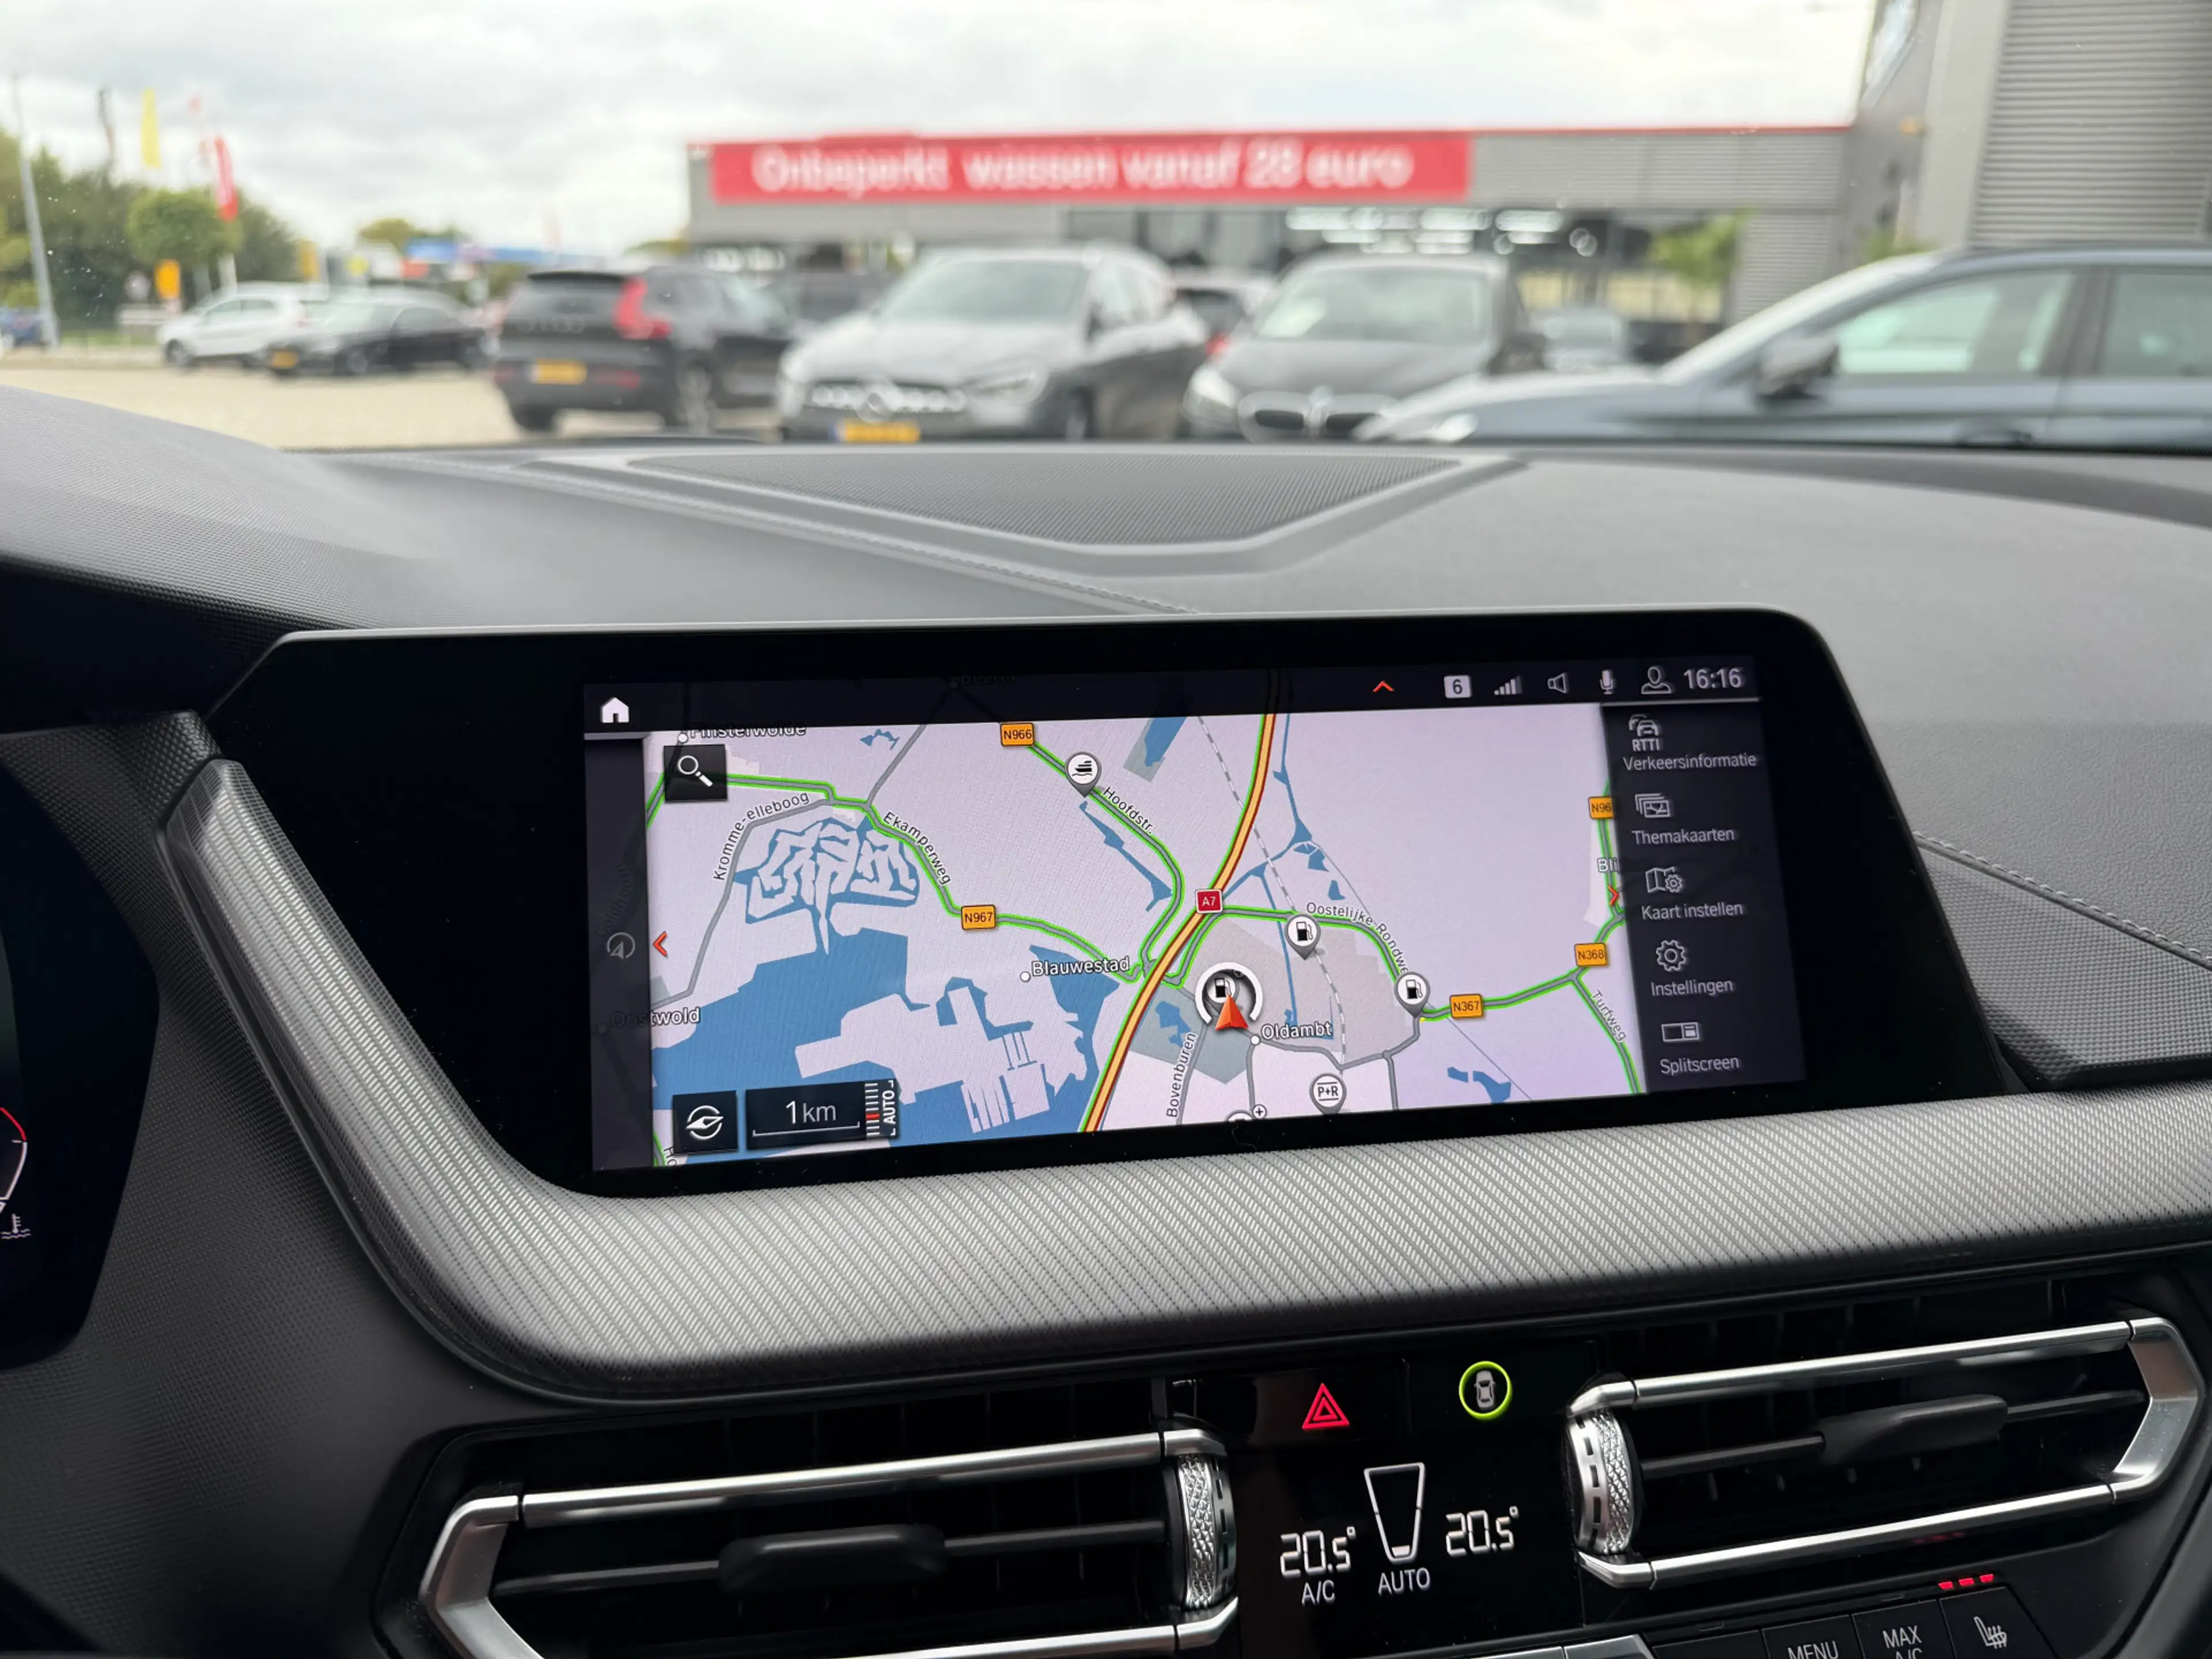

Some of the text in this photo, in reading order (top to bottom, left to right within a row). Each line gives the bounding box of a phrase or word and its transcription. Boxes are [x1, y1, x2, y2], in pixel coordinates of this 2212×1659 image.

[1306, 143, 1414, 189] euro
[1452, 679, 1463, 694] 6
[1683, 667, 1743, 690] 16:16
[1003, 728, 1033, 741] N966
[1631, 738, 1660, 751] RTTI
[1623, 752, 1758, 771] Verkeersinformatie
[1103, 786, 1154, 834] Hoofdstr.
[714, 791, 810, 881] Kromme-elleboog
[1631, 827, 1736, 845] Themakaarten
[882, 811, 952, 887] Ekamperweg
[1202, 895, 1217, 908] A7
[964, 911, 994, 924] N967
[1306, 902, 1373, 926] Oostelijke
[1641, 902, 1744, 921] Kaart instellen
[1578, 949, 1605, 961] N368
[1031, 956, 1130, 976] Blauwestad
[1651, 980, 1735, 998] Instellingen
[1453, 999, 1480, 1013] N367
[1590, 988, 1627, 1042] Turfweg
[1261, 1021, 1334, 1040] Oldambt
[1166, 1032, 1197, 1118] Bovenburen
[1660, 1056, 1740, 1075] Splitscreen
[1317, 1085, 1339, 1098] P+R
[882, 1090, 896, 1124] AUTO
[1378, 1567, 1431, 1596] AUTO
[1301, 1580, 1336, 1606] A/C
[1882, 1625, 1922, 1649] MAX
[1787, 1640, 1839, 1659] MENU
